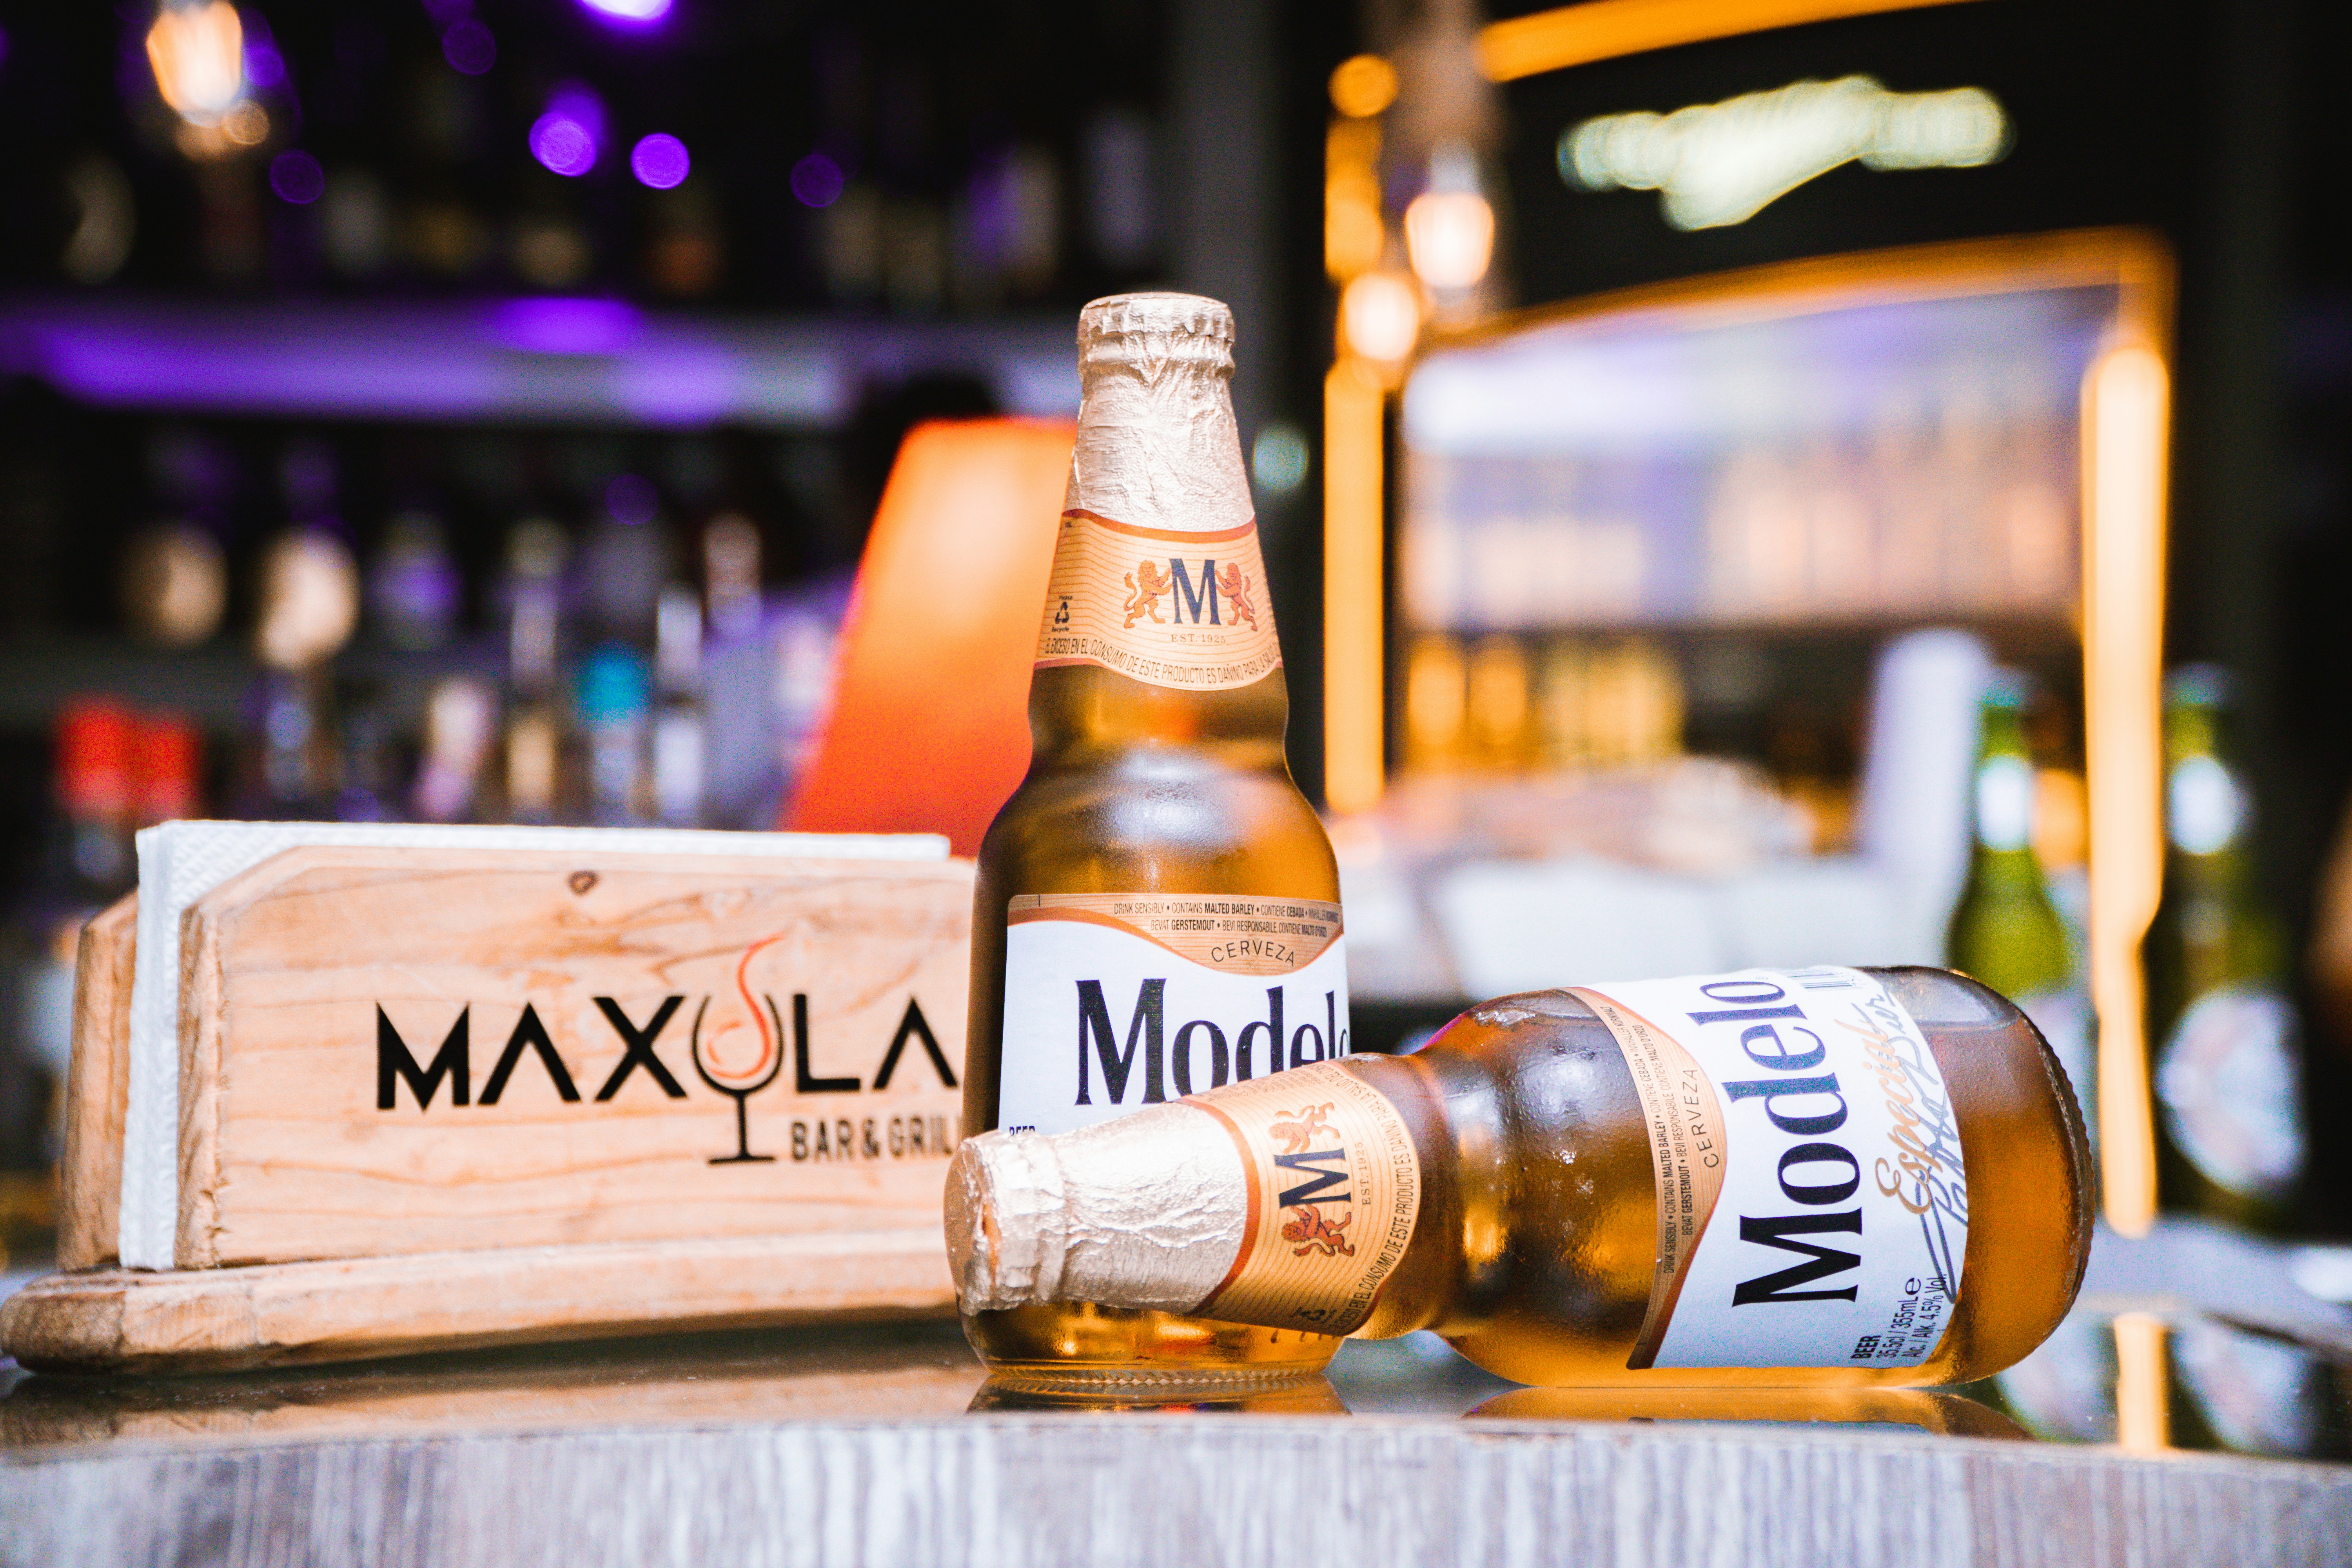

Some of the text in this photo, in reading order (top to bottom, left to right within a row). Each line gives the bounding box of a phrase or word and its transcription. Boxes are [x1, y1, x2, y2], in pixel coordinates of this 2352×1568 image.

[1169, 558, 1222, 625] M
[1171, 634, 1226, 644] EST. 1925
[1071, 638, 1080, 654] EN
[1080, 639, 1089, 654] EL
[1090, 639, 1127, 668] CONSUMO
[1126, 655, 1140, 673] DE
[1138, 659, 1161, 678] ESTE
[1161, 664, 1205, 684] PRODUCTO
[1207, 668, 1216, 684] ES
[1217, 663, 1244, 683] DAÑINO
[1114, 903, 1133, 914] DRINK
[1134, 902, 1165, 914] SENSIBLY
[1172, 902, 1203, 914] CONTAINS
[1205, 902, 1229, 914] MALTED
[1231, 903, 1255, 915] BARLEY
[1261, 904, 1285, 916] CONTIENE
[1150, 919, 1169, 931] BEVAT
[1171, 919, 1215, 931] GERSTEMOUT
[1222, 920, 1235, 931] BEVI
[1237, 920, 1278, 934] RESPONSABILE,
[1211, 940, 1295, 967] CERVEZA
[1633, 1058, 1651, 1081] CEBADA
[1336, 1078, 1367, 1096] SALUD
[1360, 1091, 1377, 1104] LA
[1642, 1083, 1661, 1113] CONTIENE
[1368, 1099, 1393, 1121] PARA
[1682, 1070, 1719, 1169] CERVEZA
[1833, 1019, 1943, 1214] Especial
[1381, 1119, 1407, 1152] DAÑINO
[1632, 1025, 1693, 1236] BEVAT GERSTEMOUT BEVI RESPONSABILE, CONTIENE MALTO D'ORZO
[1654, 1120, 1669, 1148] BARLEY
[1686, 981, 1862, 1308] Modelo
[1393, 1152, 1412, 1166] ES
[1661, 1149, 1674, 1178] MALTED
[1274, 1147, 1352, 1210] M
[1355, 1142, 1371, 1206] EST. 1925
[1395, 1167, 1414, 1216] PRODUCTO
[1663, 1179, 1676, 1214] CONTAINS
[1390, 1216, 1411, 1240] ESTE
[1664, 1221, 1676, 1254] SENSIBLY
[1385, 1238, 1403, 1254] DE
[1358, 1252, 1397, 1290] CONSUMO
[1663, 1254, 1675, 1274] DRINK
[1924, 1274, 1947, 1293] Vol.
[1891, 1296, 1919, 1329] 355mL
[1919, 1295, 1944, 1320] 4.5%
[1911, 1322, 1936, 1338] Alk.
[1850, 1335, 1882, 1359] BEER
[1876, 1336, 1907, 1359] 35.5cl
[1901, 1345, 1927, 1358] Alc.
